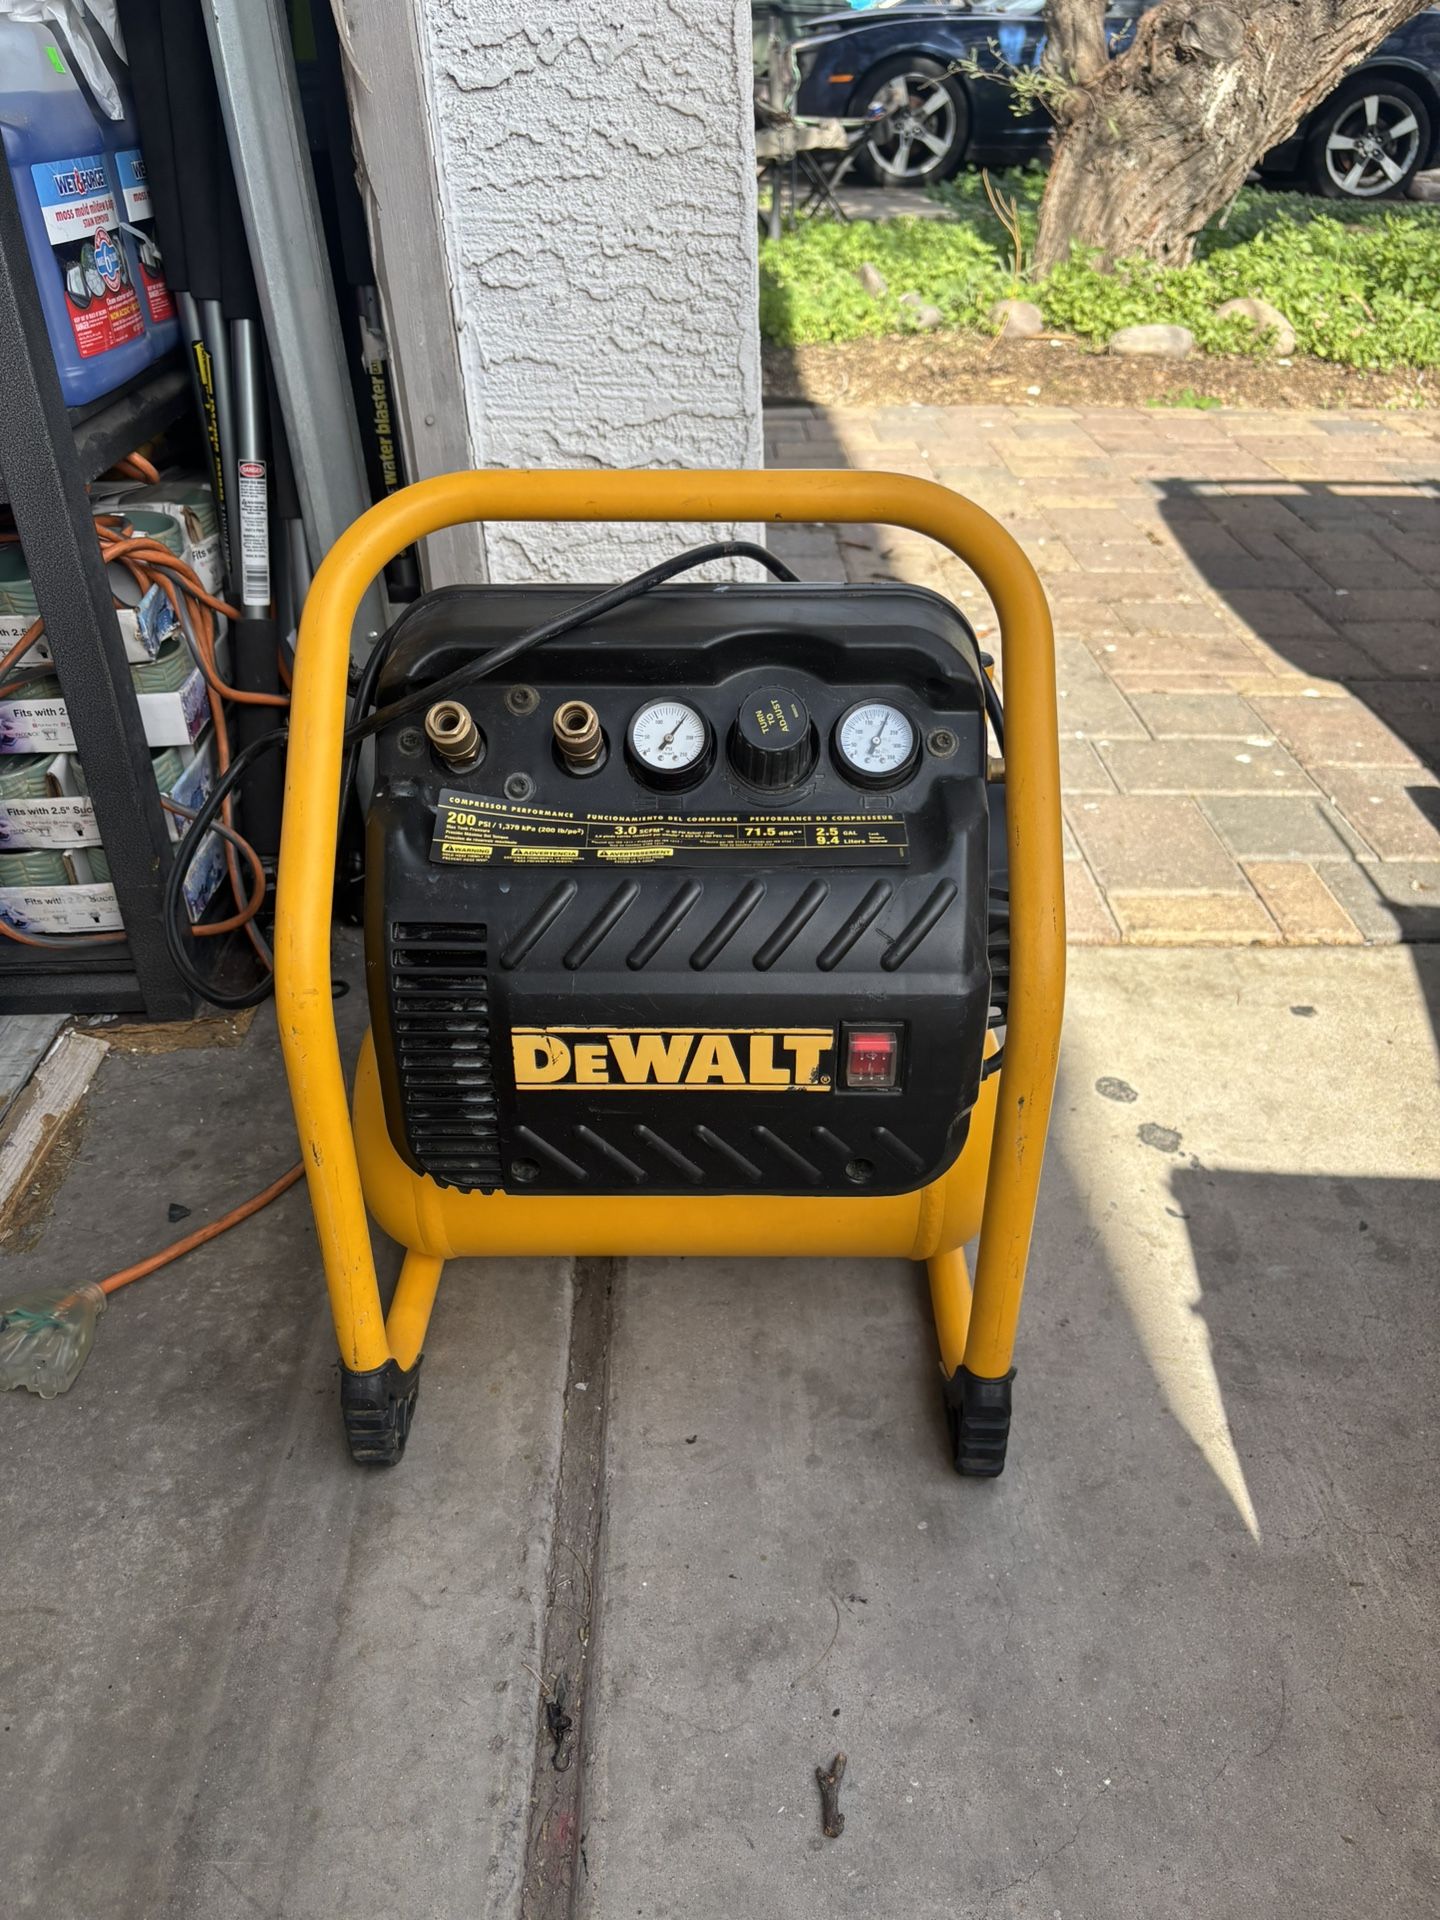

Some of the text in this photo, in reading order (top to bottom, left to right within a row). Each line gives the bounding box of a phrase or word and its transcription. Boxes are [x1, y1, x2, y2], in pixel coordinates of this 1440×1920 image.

[55, 209, 75, 222] moss
[75, 203, 89, 217] mold
[371, 376, 391, 435] blaster
[380, 436, 397, 486] water
[192, 550, 206, 560] Fits
[12, 628, 28, 636] 2.5
[13, 708, 33, 717] Fits
[34, 707, 57, 717] with
[771, 700, 789, 732] ADJUST
[755, 710, 770, 734] TURN
[766, 713, 775, 726] TO
[7, 806, 93, 816] Fits with 2.5" Suc
[449, 797, 574, 818] COMPRESSOR PERFORMANCE
[447, 811, 476, 826] 200
[538, 826, 556, 834] (200
[587, 814, 664, 822] FUNCIONAMIENTO
[614, 826, 637, 835] 3.0
[745, 827, 776, 836] 71.5
[816, 827, 839, 836] 2.5
[816, 836, 840, 845] 9.4
[511, 1034, 832, 1084] DEWALT
